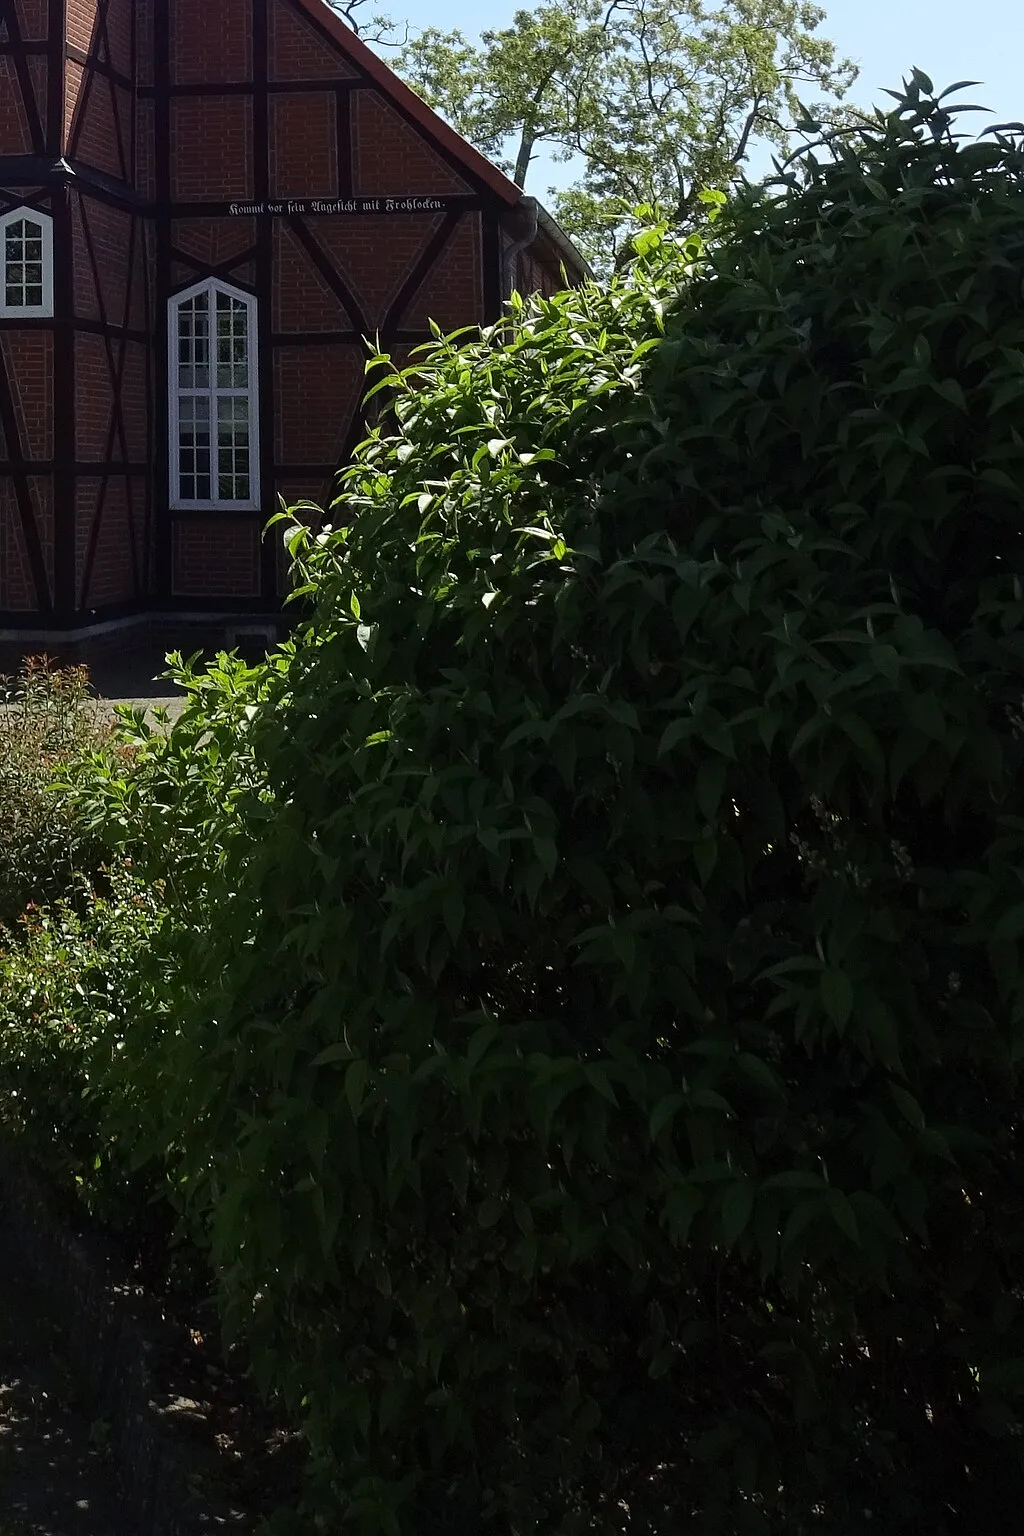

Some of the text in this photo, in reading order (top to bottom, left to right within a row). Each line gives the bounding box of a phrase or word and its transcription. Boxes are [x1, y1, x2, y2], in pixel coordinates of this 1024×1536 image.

[228, 203, 264, 216] Kommt
[268, 203, 283, 213] vor
[362, 199, 379, 211] mit
